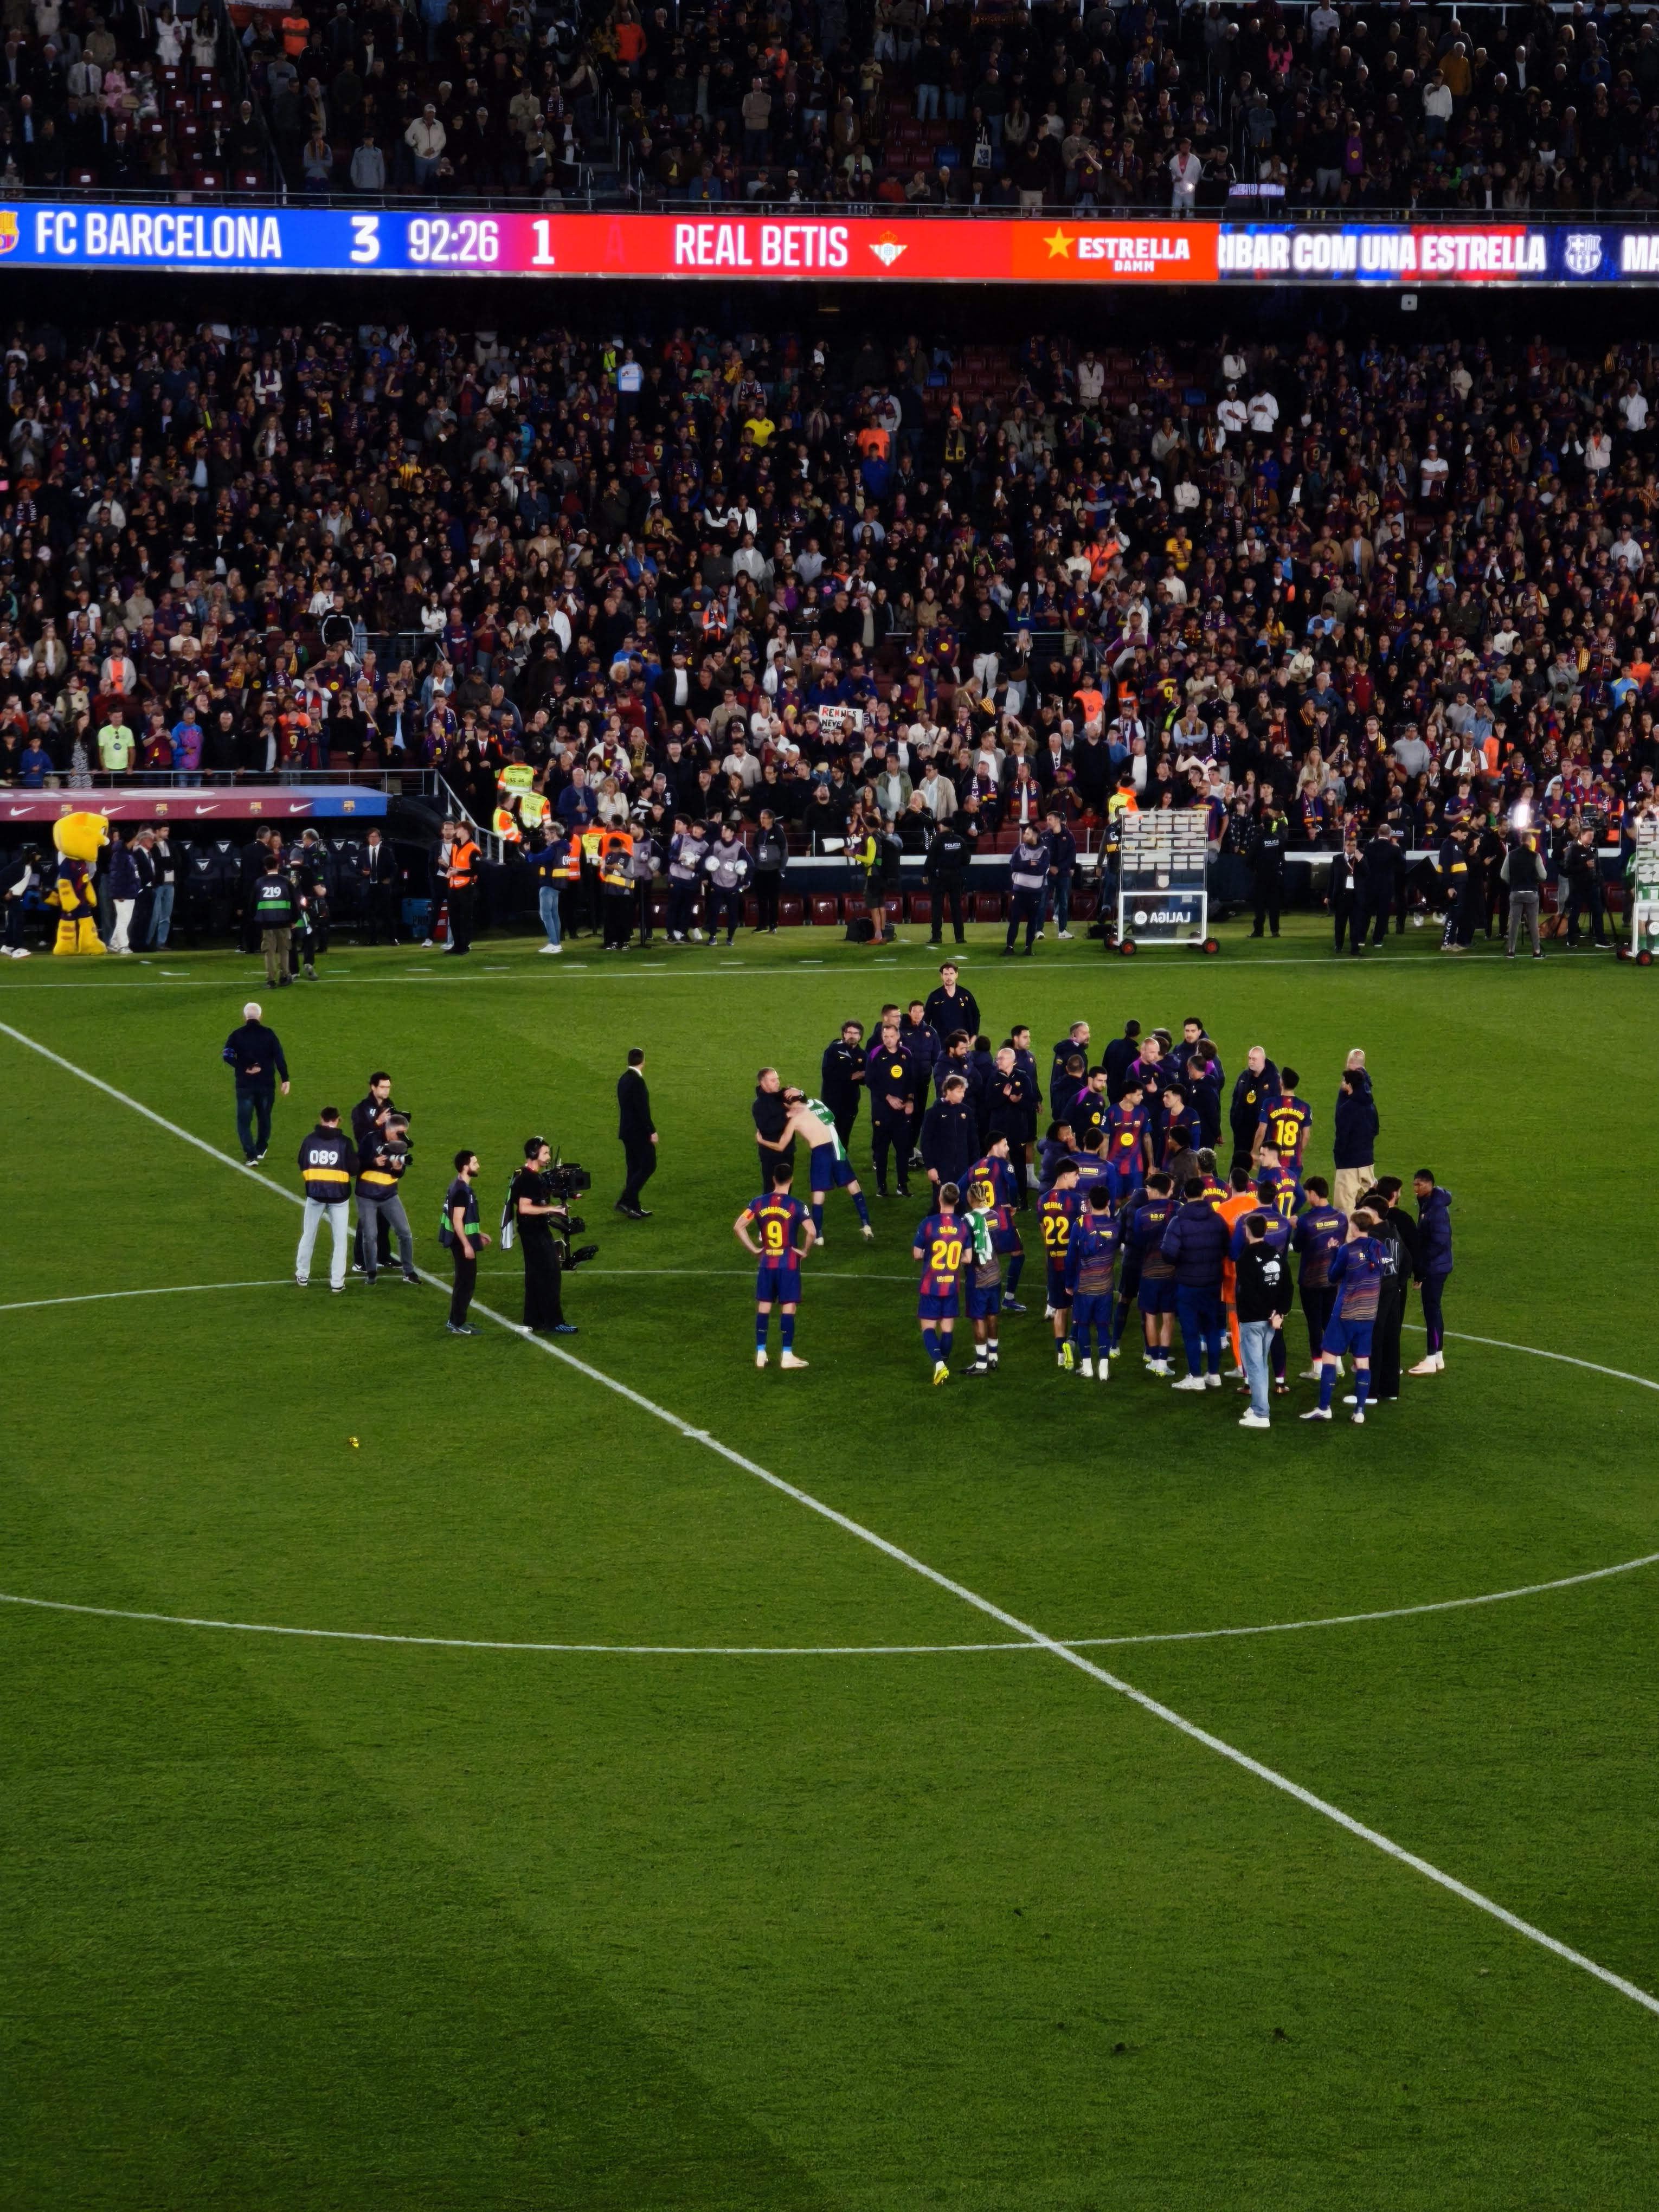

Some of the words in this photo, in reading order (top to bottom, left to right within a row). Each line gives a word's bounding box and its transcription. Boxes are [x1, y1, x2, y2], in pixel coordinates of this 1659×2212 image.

[36, 211, 76, 254] FC
[86, 213, 281, 258] BARCELONA
[351, 216, 380, 262] 3
[409, 219, 498, 262] 92:26
[532, 220, 554, 264] 1
[676, 224, 752, 266] REAL
[762, 226, 848, 267] BETIS
[1079, 237, 1190, 260] ESTRELLA
[1294, 234, 1356, 269] COM
[1361, 235, 1417, 269] UNA
[1422, 236, 1546, 270] ESTRELLA
[1115, 260, 1154, 272] DAMM
[654, 445, 663, 460] 9
[822, 709, 857, 719] RENNES
[290, 735, 298, 749] 9
[262, 887, 281, 898] 219
[1276, 1120, 1298, 1147] 18
[310, 1150, 338, 1165] 089
[1277, 1192, 1294, 1219] 17
[767, 1221, 782, 1248] 9
[938, 1226, 958, 1235] OLMO
[1043, 1216, 1070, 1245] 22
[931, 1240, 962, 1270] 20
